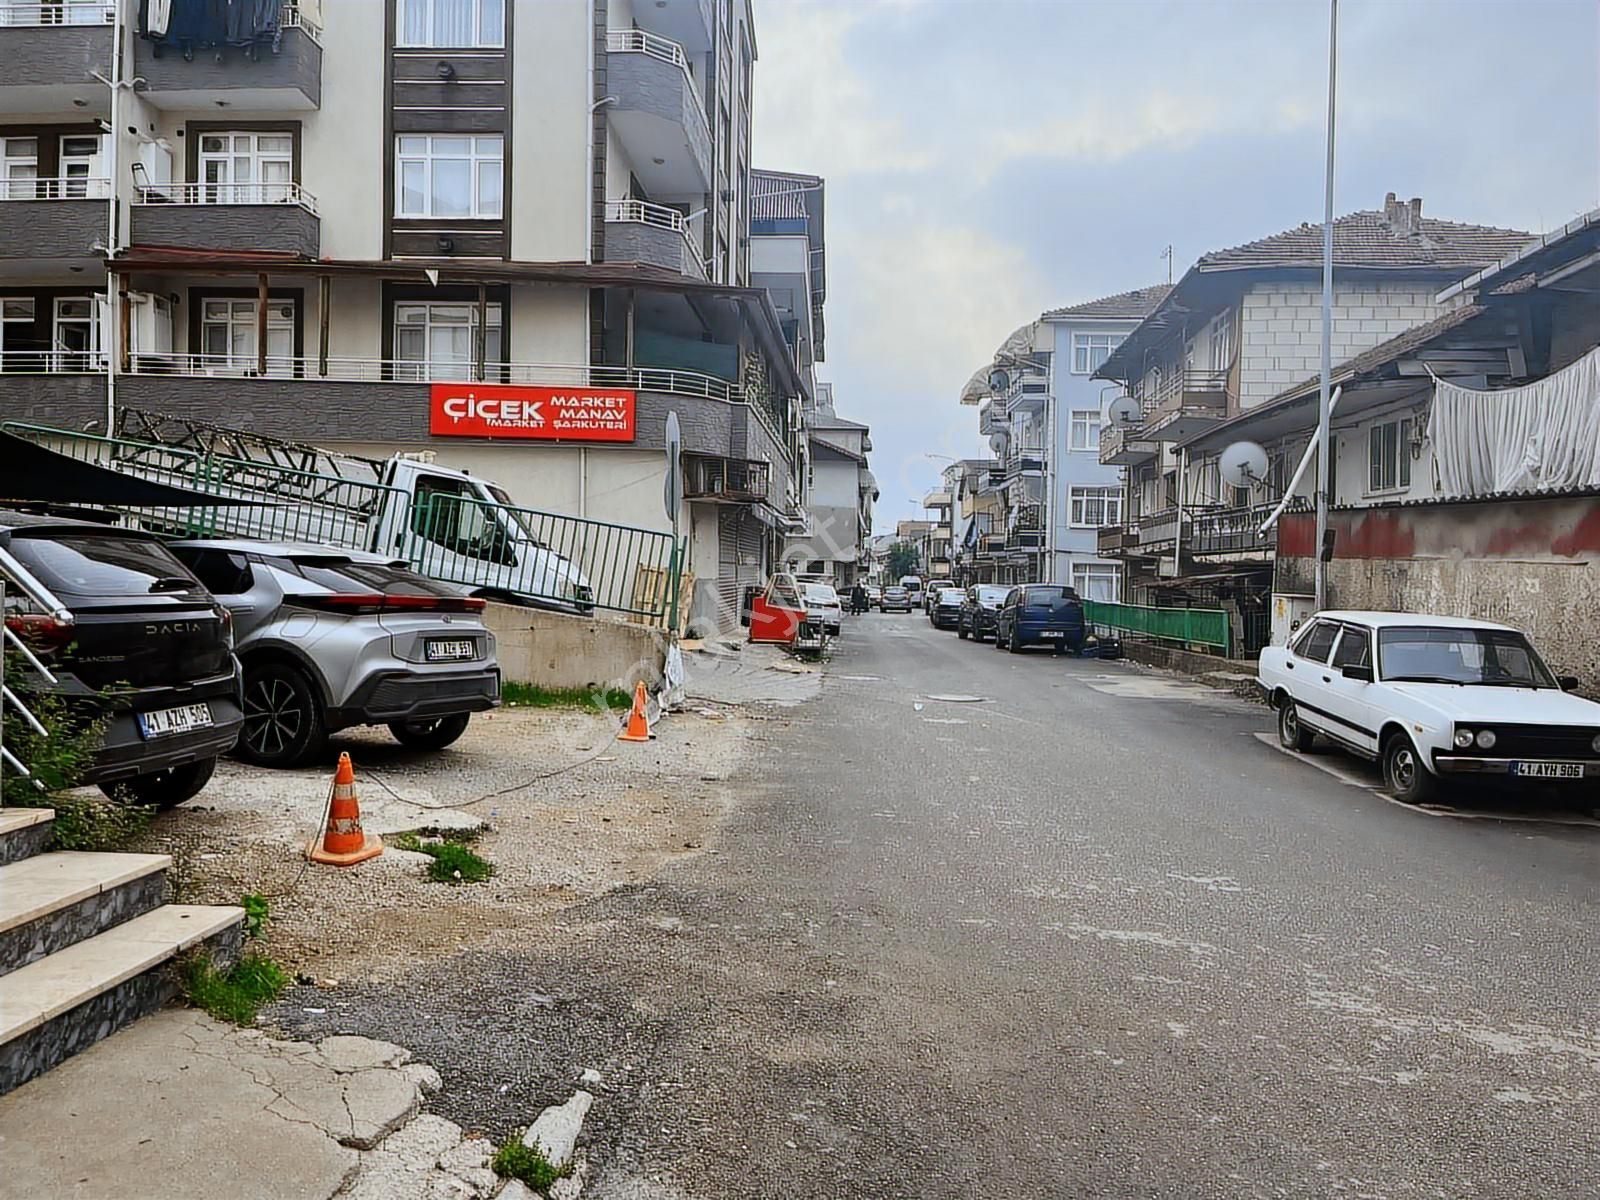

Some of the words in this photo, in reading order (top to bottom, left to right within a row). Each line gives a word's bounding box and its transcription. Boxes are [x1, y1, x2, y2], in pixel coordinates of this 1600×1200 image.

[551, 396, 626, 408] MARKET
[560, 409, 626, 420] MANAV
[490, 419, 545, 429] MARKET
[146, 623, 201, 634] DACIA
[146, 713, 161, 732] 41
[165, 708, 188, 728] AZH
[1519, 763, 1532, 775] 41
[1536, 764, 1558, 776] AYH
